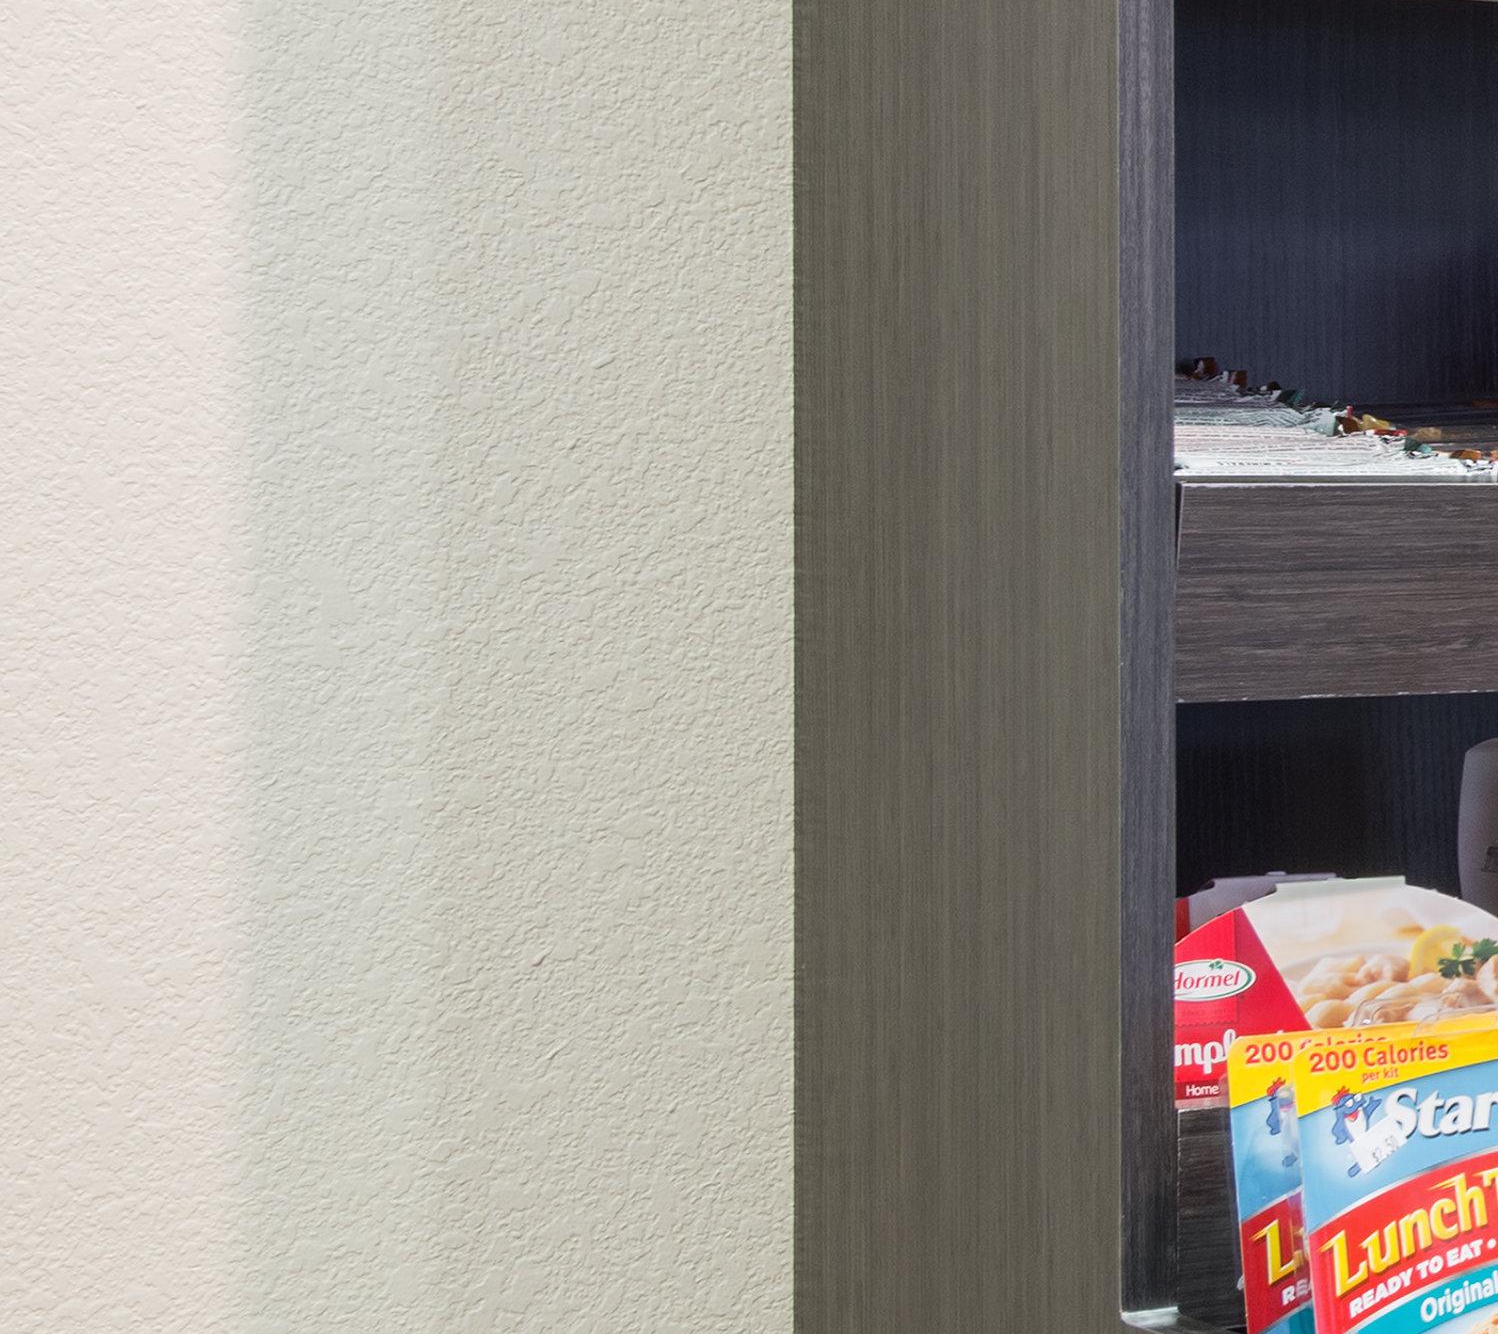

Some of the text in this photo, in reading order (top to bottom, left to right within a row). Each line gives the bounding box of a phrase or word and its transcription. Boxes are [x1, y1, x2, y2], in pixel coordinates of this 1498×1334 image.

[1244, 1041, 1294, 1065] 200
[1308, 1037, 1450, 1074] 200 Calories
[1361, 1066, 1400, 1084] per kit
[1349, 1274, 1412, 1319] READY
[1416, 1257, 1443, 1282] TO
[1446, 1238, 1484, 1269] EAT
